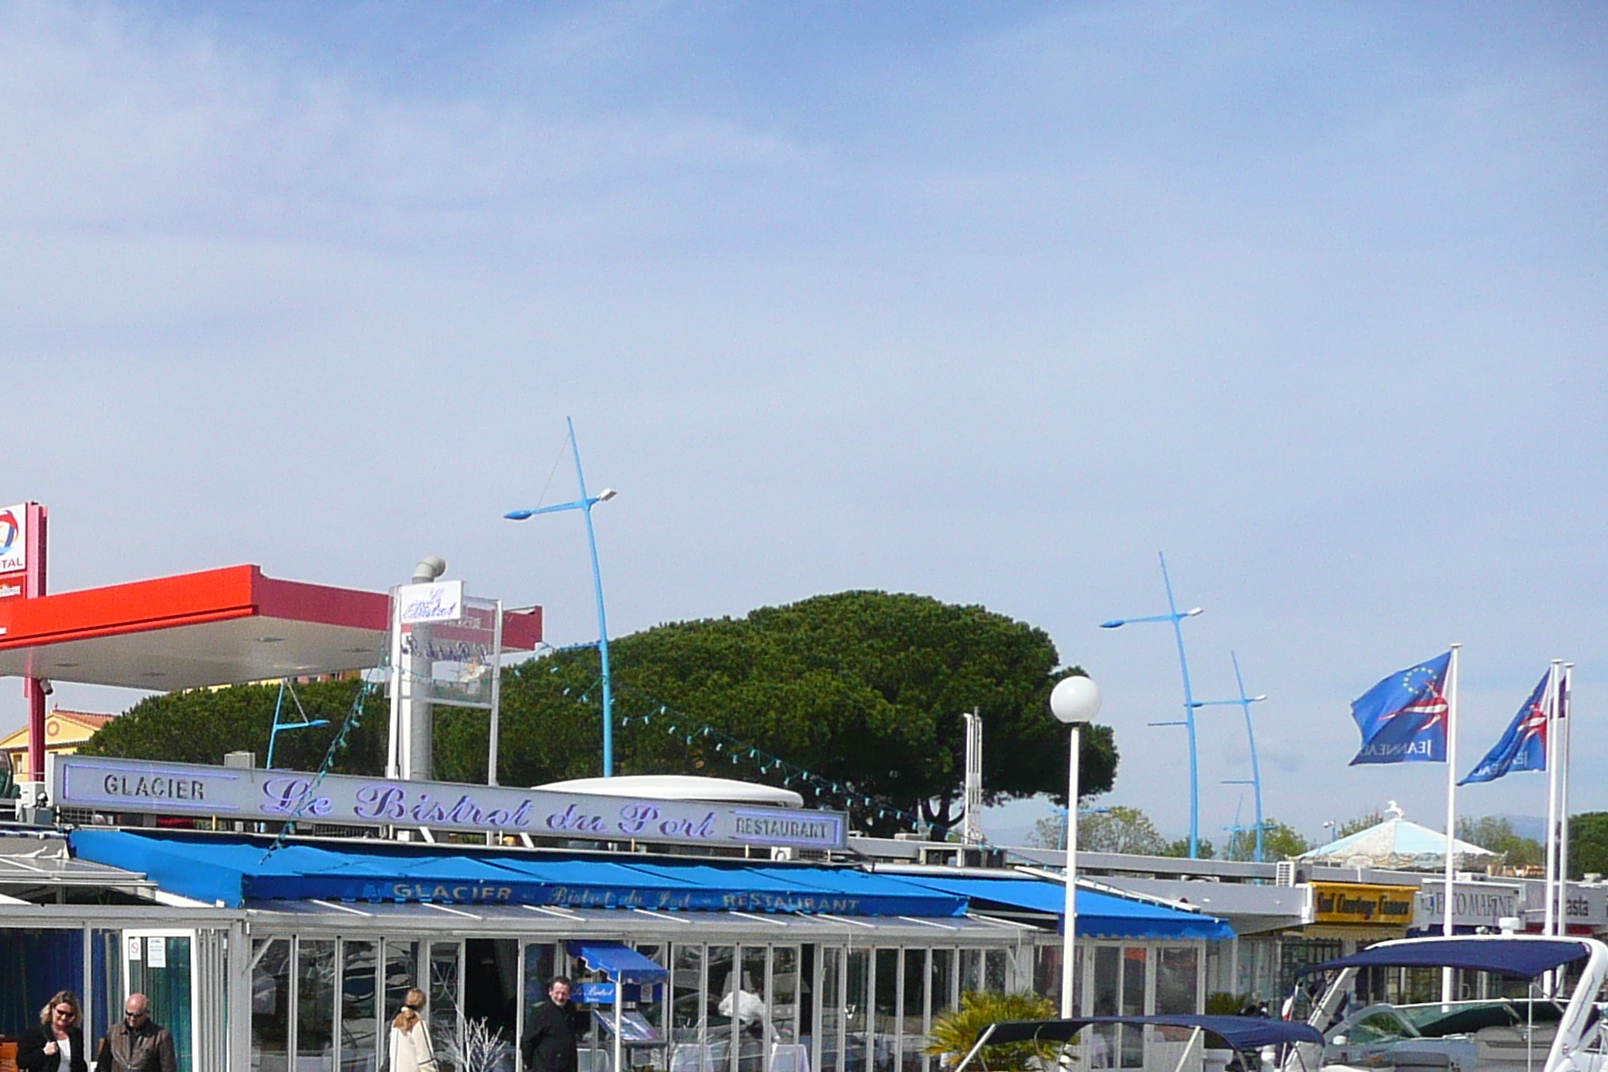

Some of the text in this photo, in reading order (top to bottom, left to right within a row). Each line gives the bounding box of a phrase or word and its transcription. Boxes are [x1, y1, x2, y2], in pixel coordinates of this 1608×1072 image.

[103, 774, 205, 801] GLACIER
[260, 777, 718, 838] Le Bistrot du Port
[735, 815, 827, 840] RESTAURANT
[393, 881, 512, 900] GLACIER
[722, 893, 860, 911] RESTAURANT
